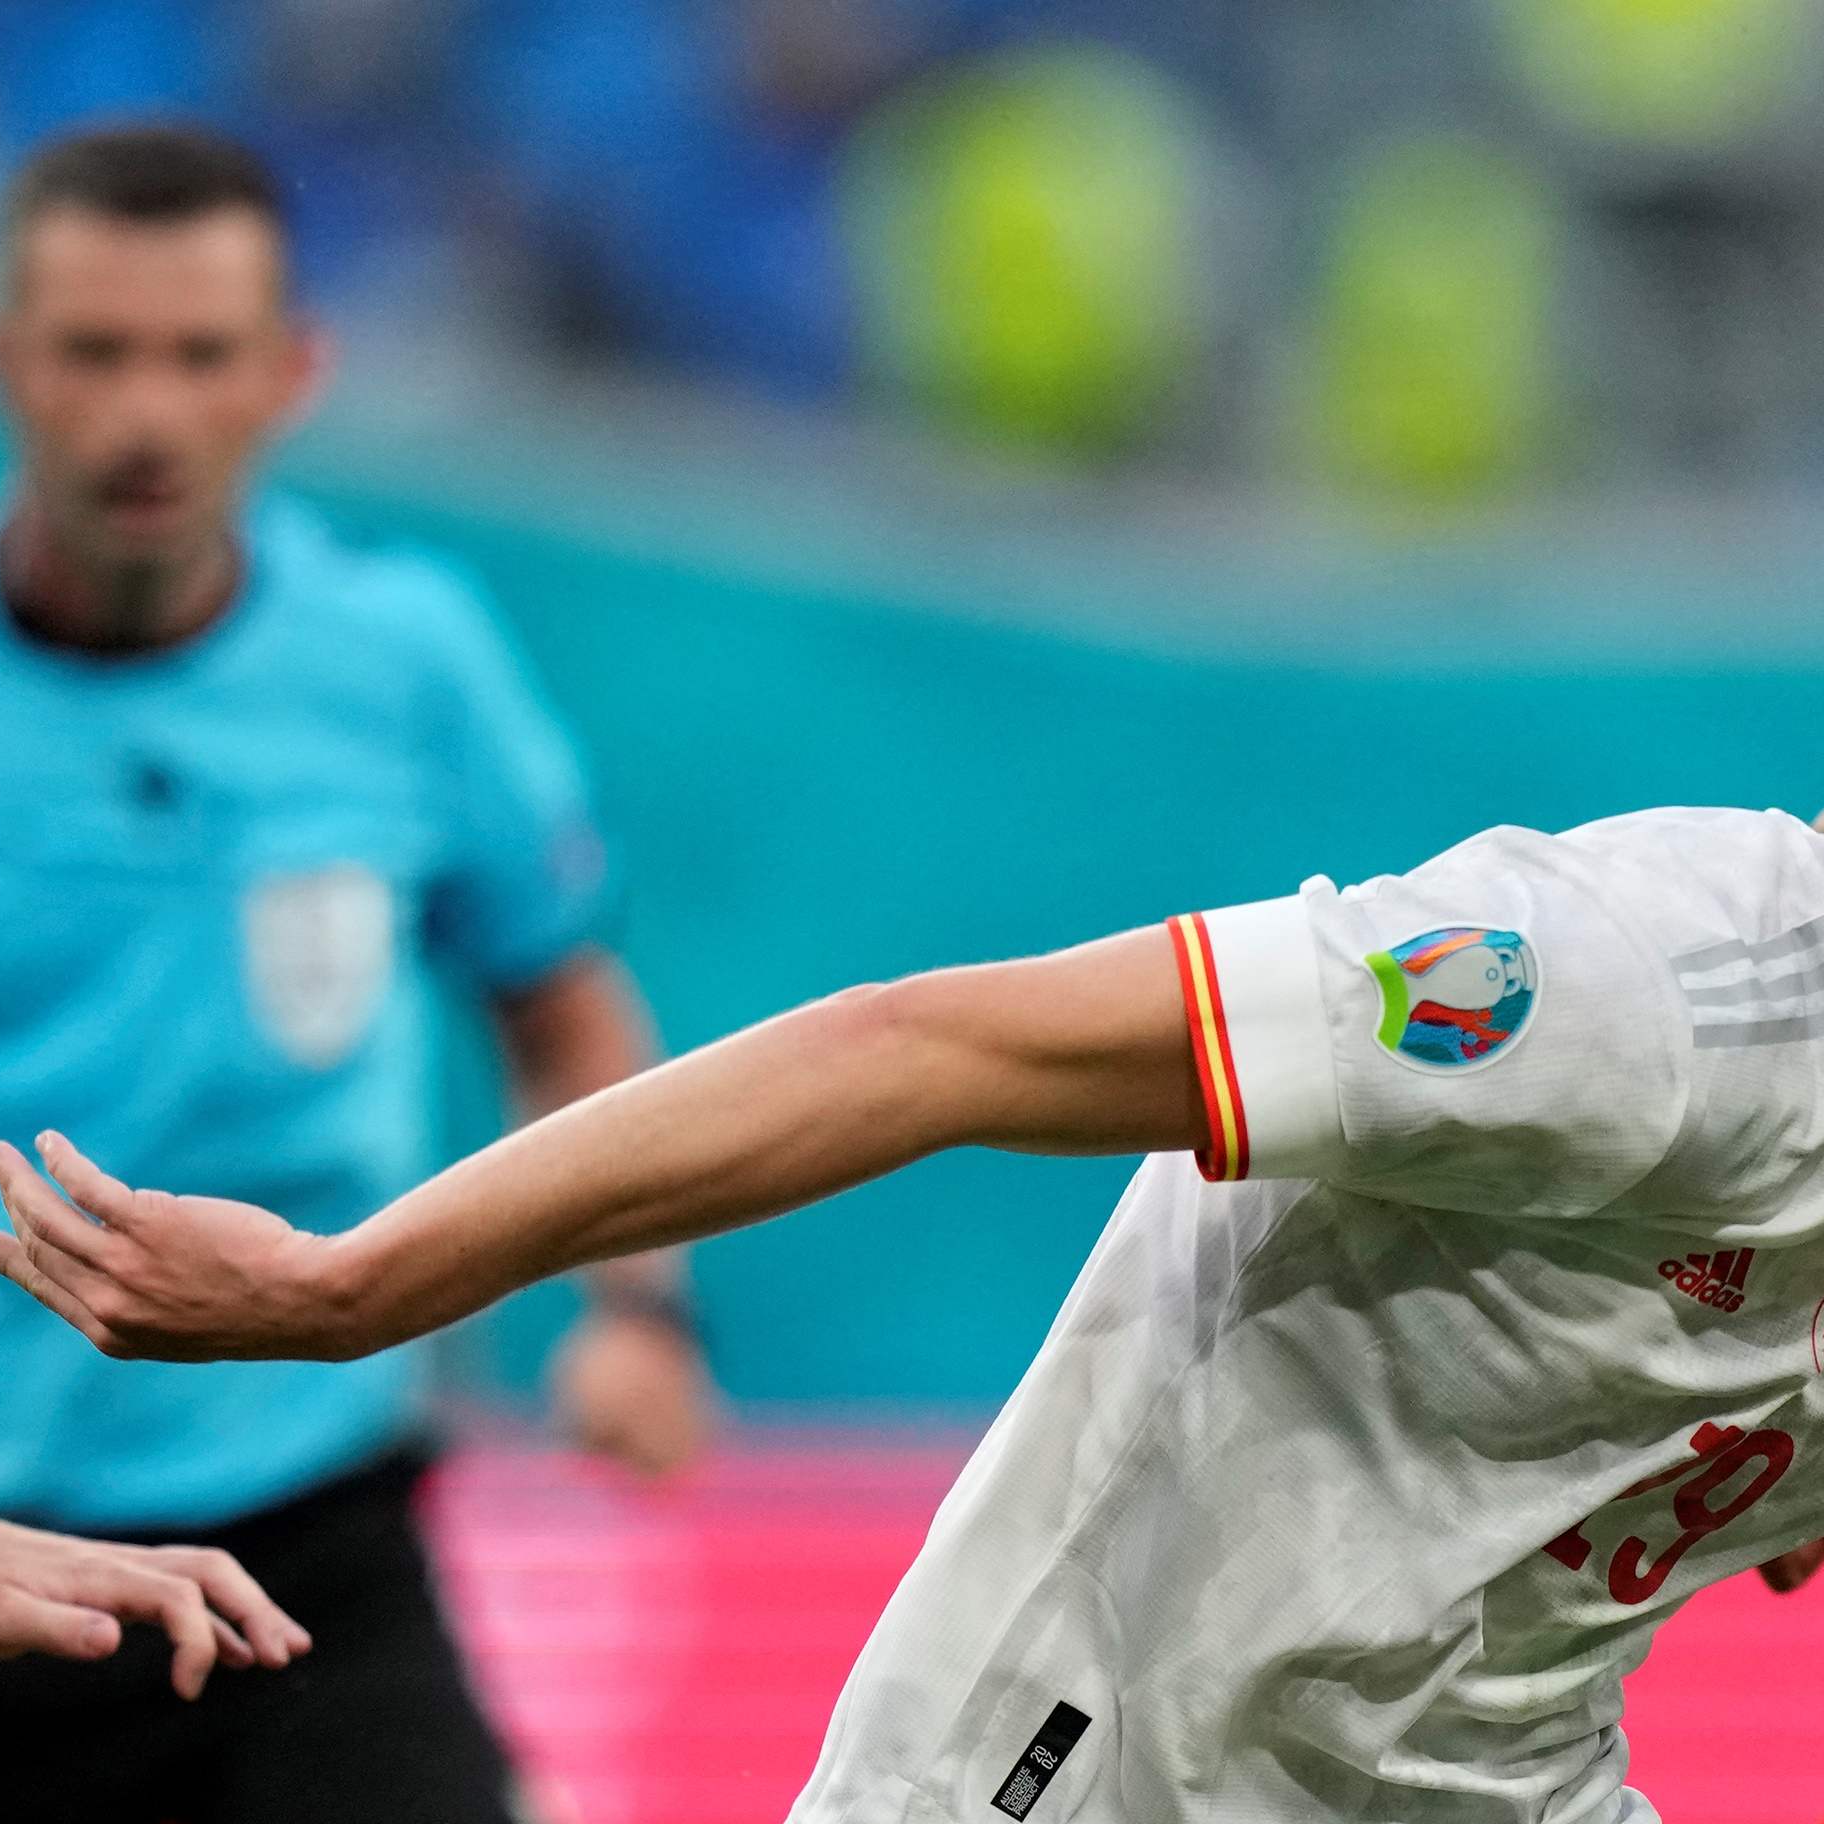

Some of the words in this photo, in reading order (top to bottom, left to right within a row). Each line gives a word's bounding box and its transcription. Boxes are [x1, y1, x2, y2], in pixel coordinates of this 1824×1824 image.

[1658, 1259, 1745, 1313] adidas
[1030, 1745, 1047, 1763] 20
[1000, 1765, 1029, 1805] AUTHENTIC
[1006, 1775, 1033, 1811] LICENSED
[1015, 1782, 1039, 1816] PRODUCT
